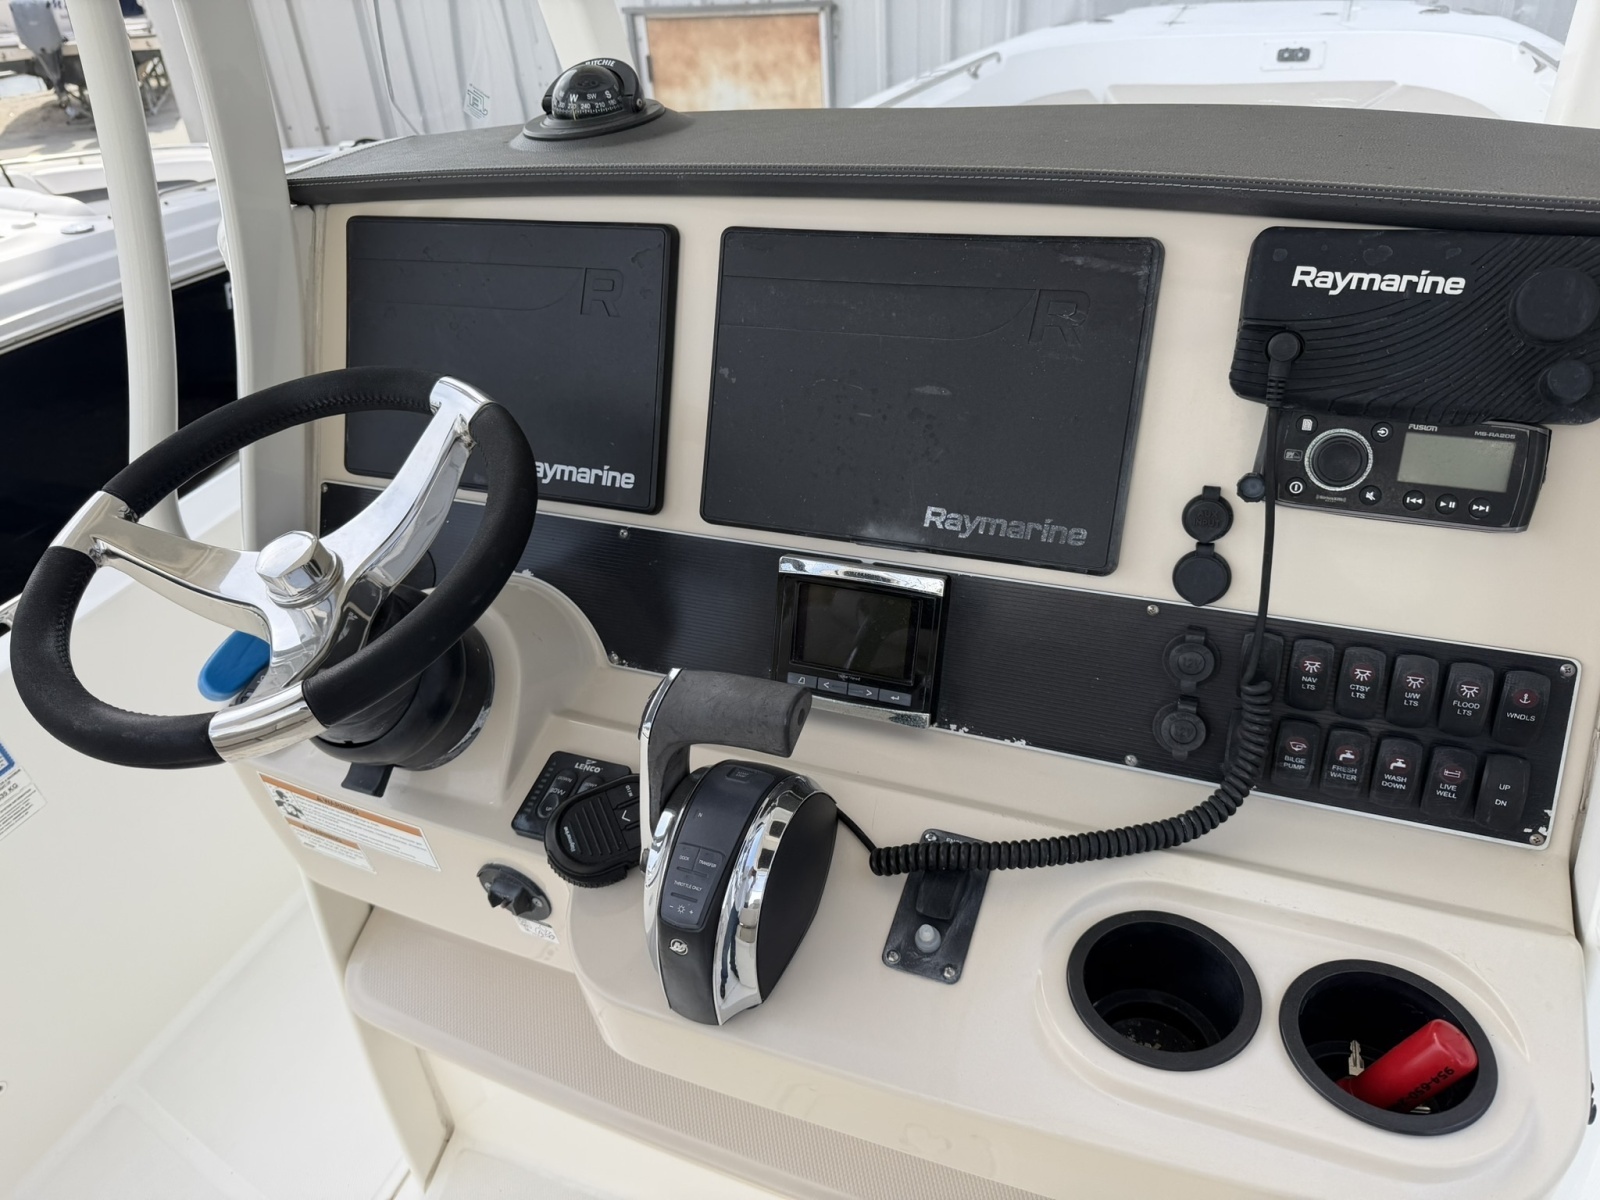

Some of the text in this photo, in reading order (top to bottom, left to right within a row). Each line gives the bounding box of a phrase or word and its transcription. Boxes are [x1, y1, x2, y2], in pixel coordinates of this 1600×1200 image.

[569, 93, 579, 103] W
[604, 90, 612, 99] S
[1291, 265, 1466, 295] Raymarine
[579, 267, 624, 318] R
[1028, 289, 1091, 345] R
[1408, 423, 1438, 432] FUSION
[1474, 430, 1516, 440] MS-RA205
[536, 460, 635, 489] aymarine
[1197, 509, 1218, 519] AUX
[923, 505, 1088, 546] Raymarine
[1192, 517, 1220, 529] INPUT
[1301, 675, 1318, 684] NAV
[1301, 683, 1316, 691] LTS
[1350, 684, 1371, 693] CTSY
[1351, 691, 1366, 700] LTS
[1404, 691, 1421, 700] U/W
[1403, 699, 1419, 708] LTS
[1452, 700, 1480, 710] FLOOD
[1457, 708, 1472, 717] LTS
[1506, 712, 1536, 722] WNDLS
[1284, 755, 1306, 764] BILGE
[574, 762, 601, 774] LENCO
[1283, 762, 1305, 771] PUMP
[1331, 764, 1358, 774] FRESH
[1329, 771, 1357, 781] WATER
[1384, 773, 1407, 783] WASH
[1381, 780, 1406, 790] DOWN
[1439, 783, 1457, 792] LIVE
[1499, 783, 1511, 791] UP
[1436, 789, 1457, 799] WELL
[1495, 798, 1507, 807] DN
[673, 880, 692, 890] THROTTLE
